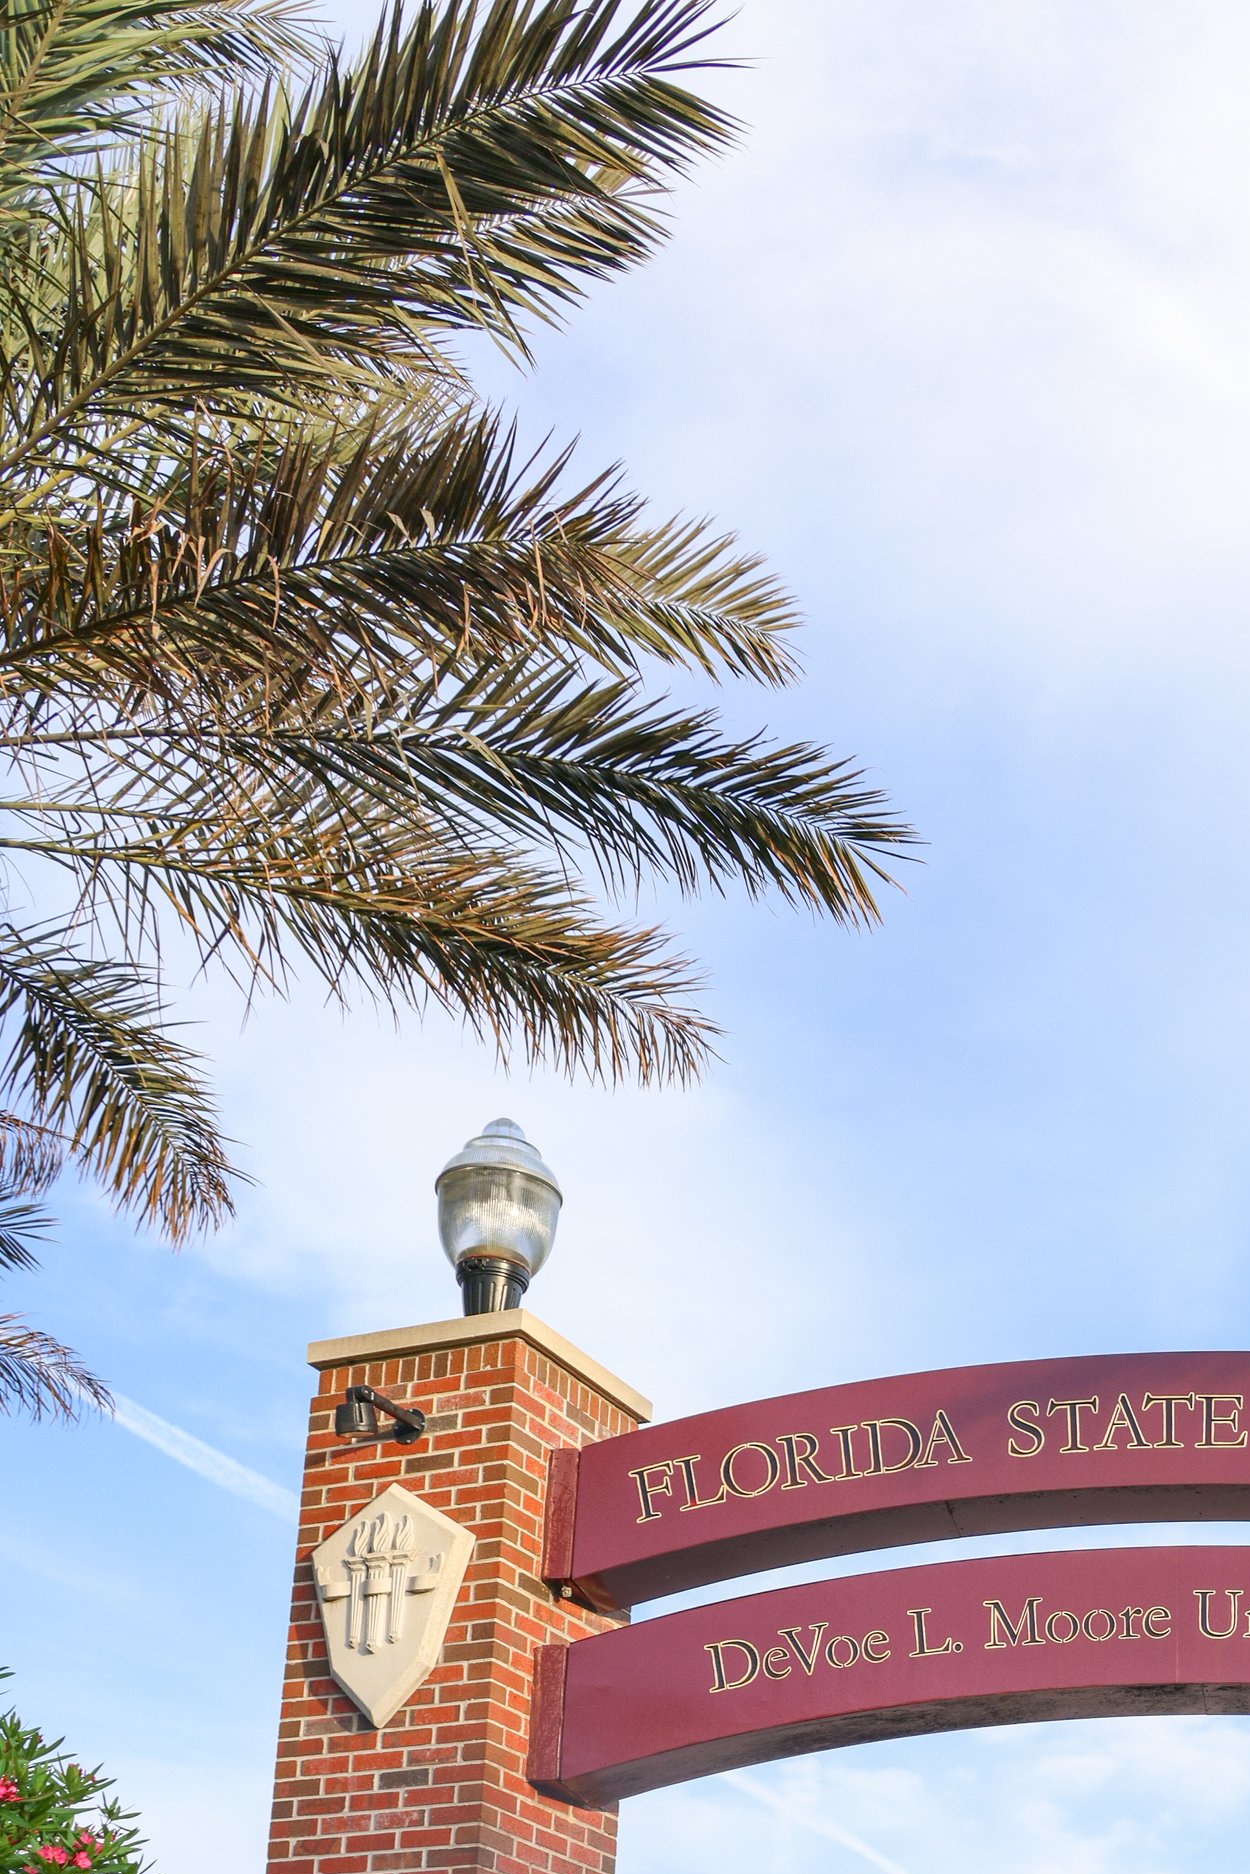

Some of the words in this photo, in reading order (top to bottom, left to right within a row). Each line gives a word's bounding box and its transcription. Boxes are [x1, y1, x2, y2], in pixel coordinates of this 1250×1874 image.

[627, 1408, 973, 1524] FLORIDA
[1007, 1391, 1249, 1458] STATE
[703, 1621, 892, 1694] DeVoe
[906, 1607, 964, 1658] L.
[982, 1596, 1172, 1650] Moore
